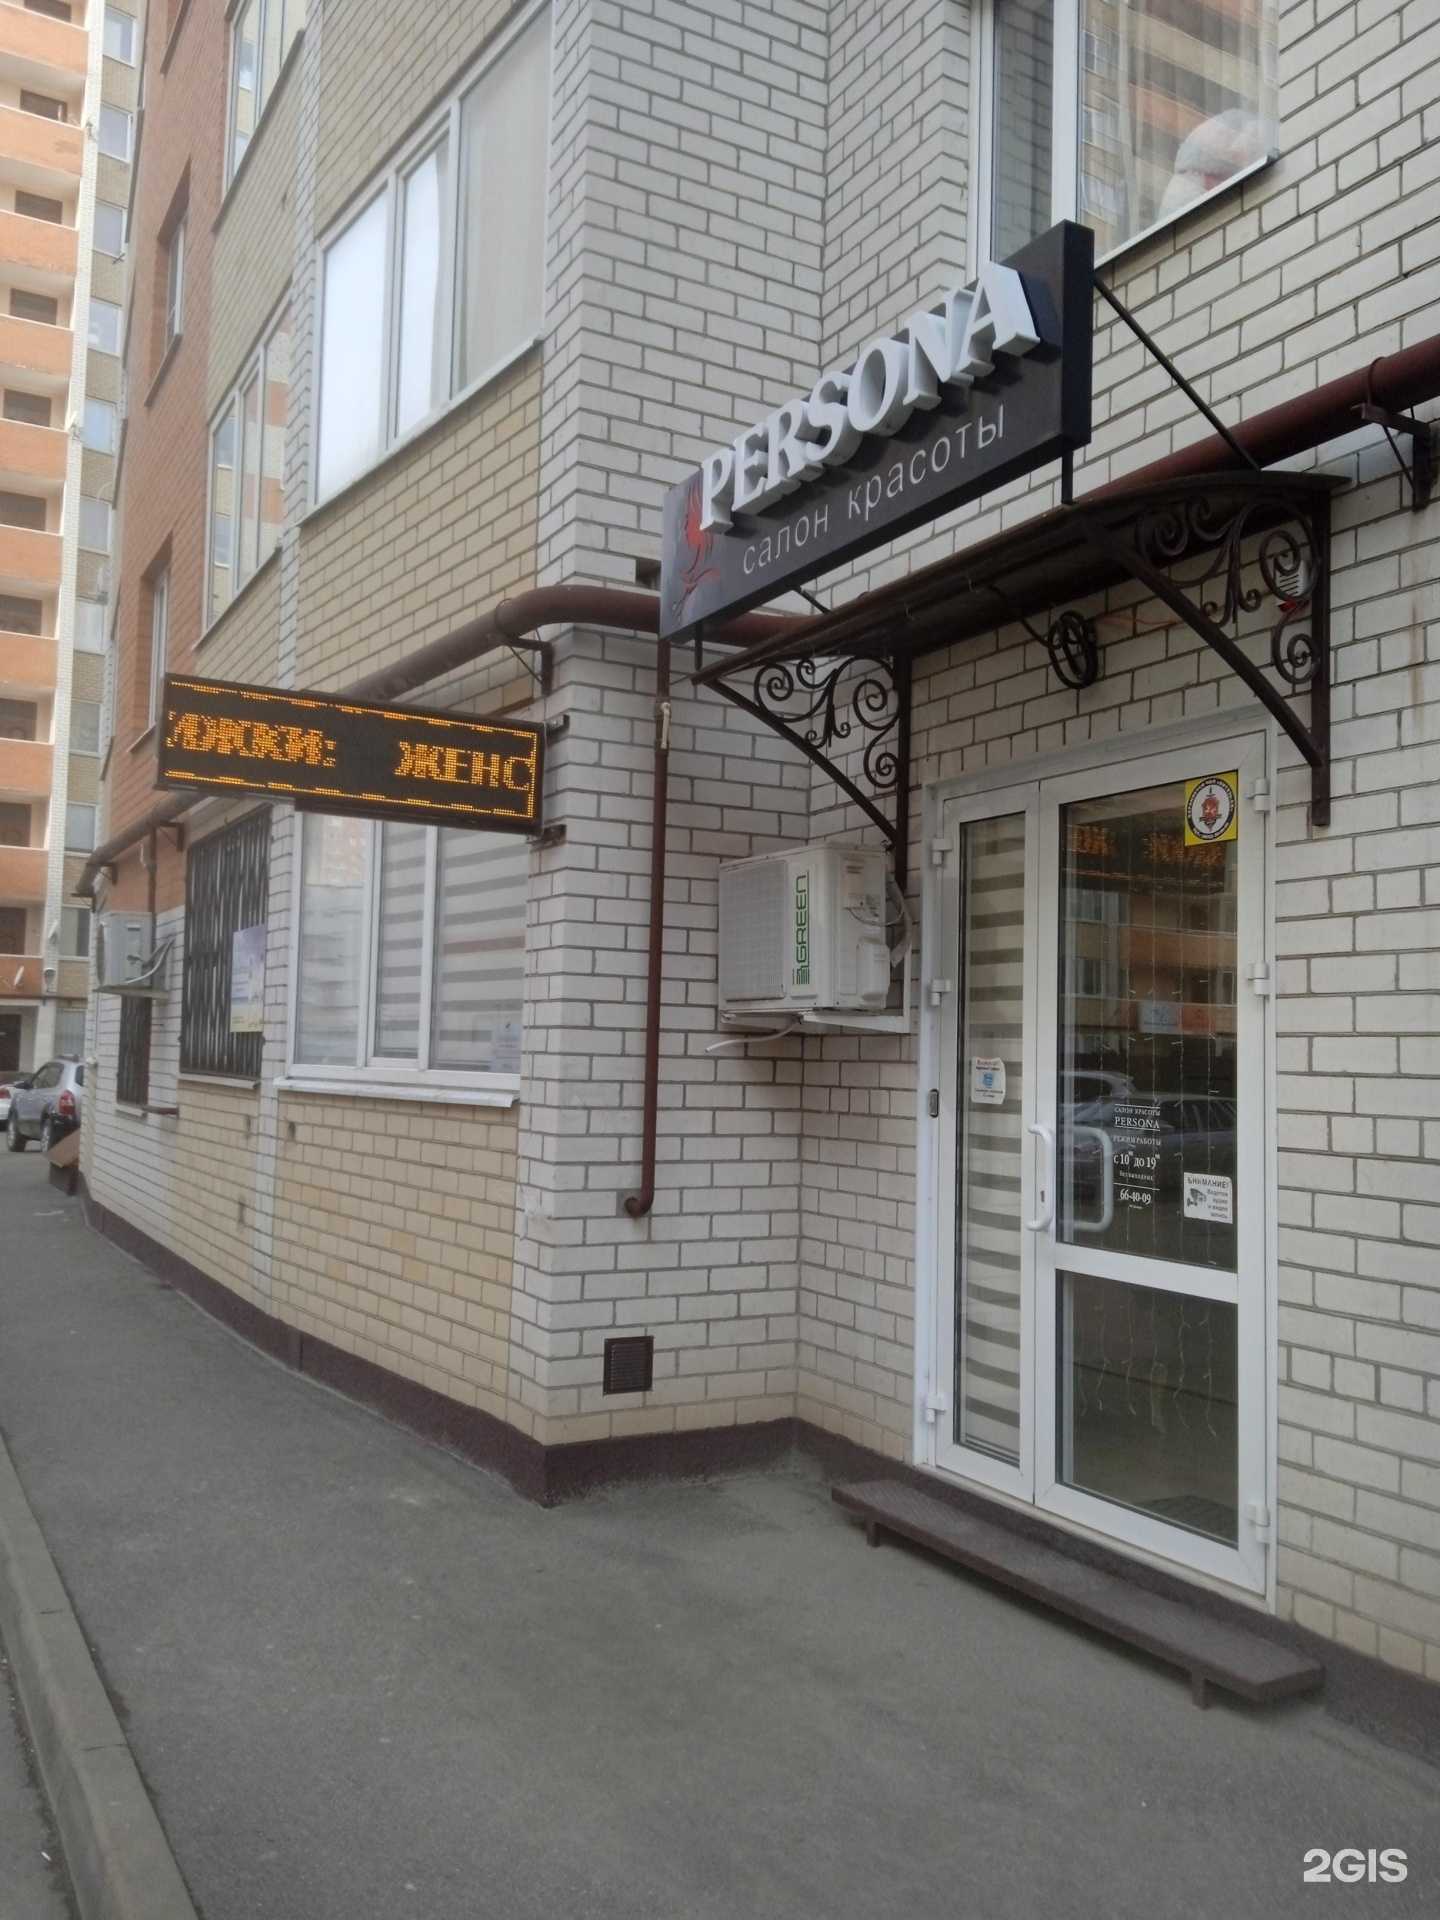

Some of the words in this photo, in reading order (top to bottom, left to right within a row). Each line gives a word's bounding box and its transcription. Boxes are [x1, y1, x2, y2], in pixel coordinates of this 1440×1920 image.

[700, 262, 1040, 533] PERSONA
[743, 512, 828, 575] салон
[848, 404, 1004, 521] красоты
[1114, 1116, 1160, 1129] PERSONA
[1120, 1189, 1152, 1205] 66-40-09
